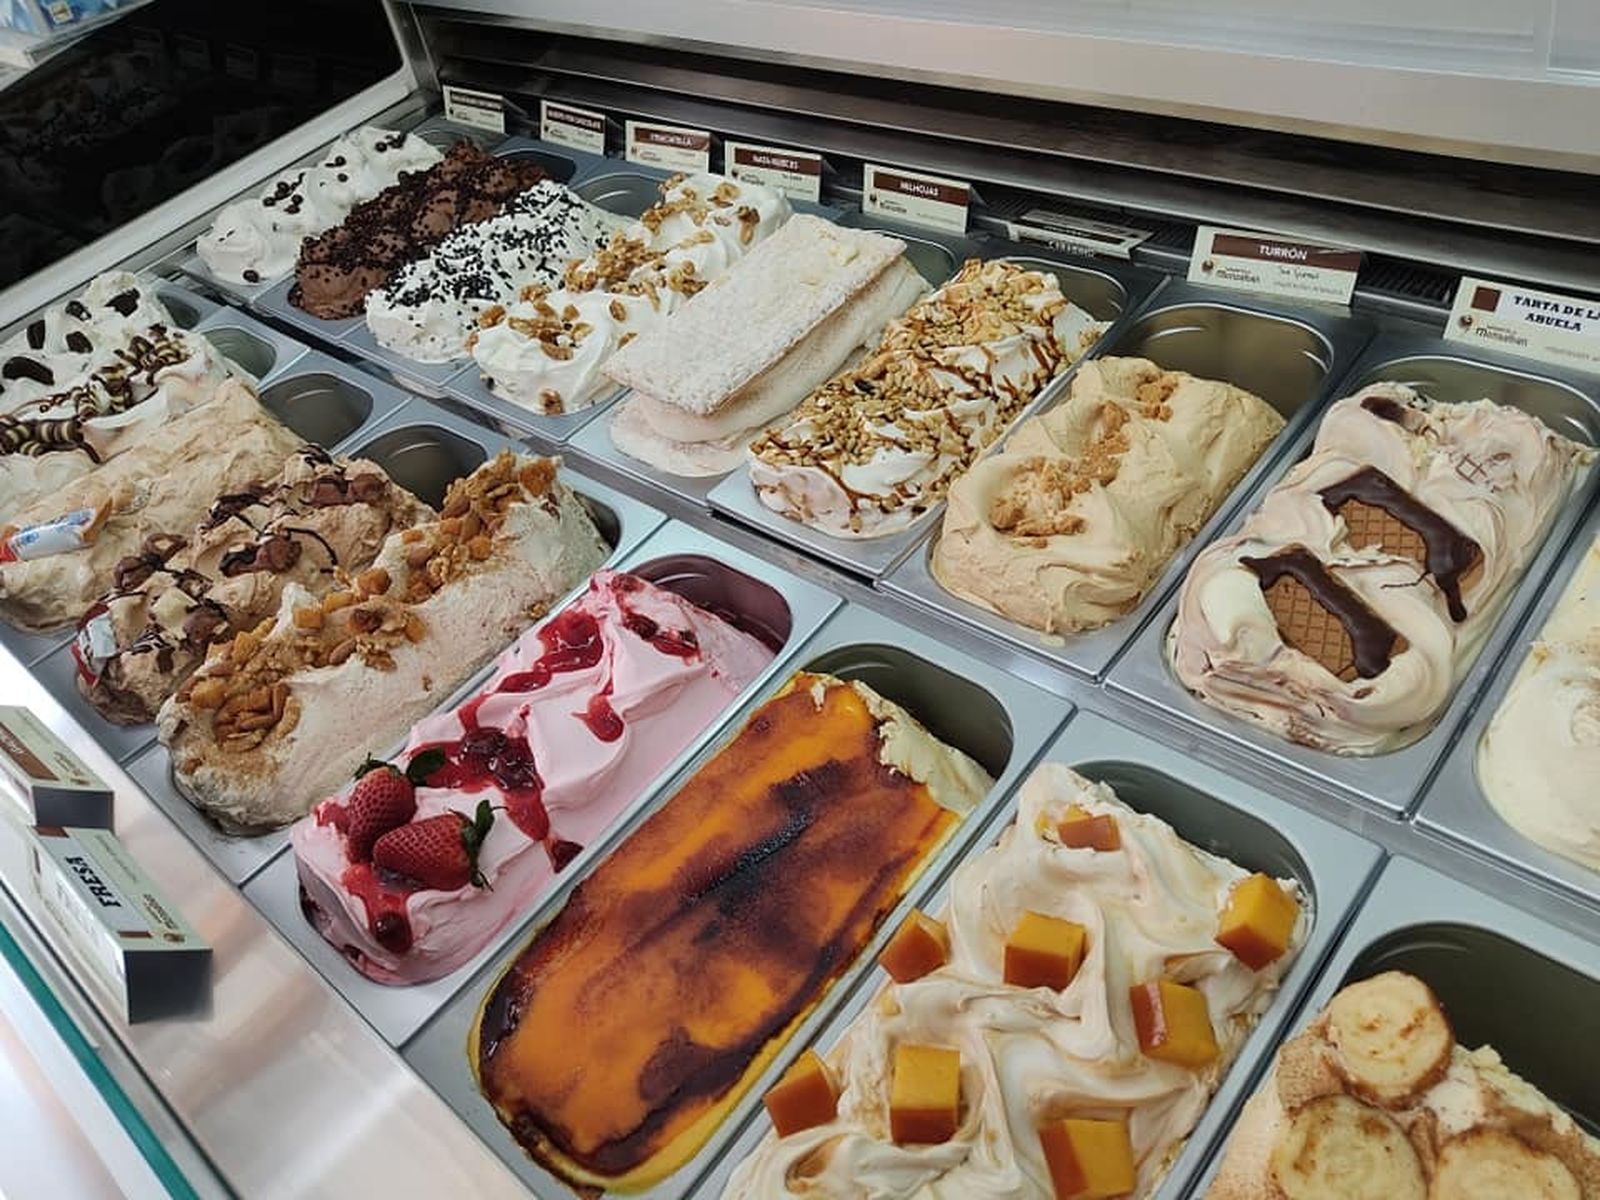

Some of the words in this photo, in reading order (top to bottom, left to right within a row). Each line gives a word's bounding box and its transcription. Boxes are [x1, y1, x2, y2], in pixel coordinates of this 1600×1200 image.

[1259, 243, 1308, 261] TURRÓN
[1514, 295, 1559, 313] TARTA
[1563, 305, 1584, 317] DE
[1525, 313, 1581, 332] ABUELA
[65, 857, 122, 907] FRESA
